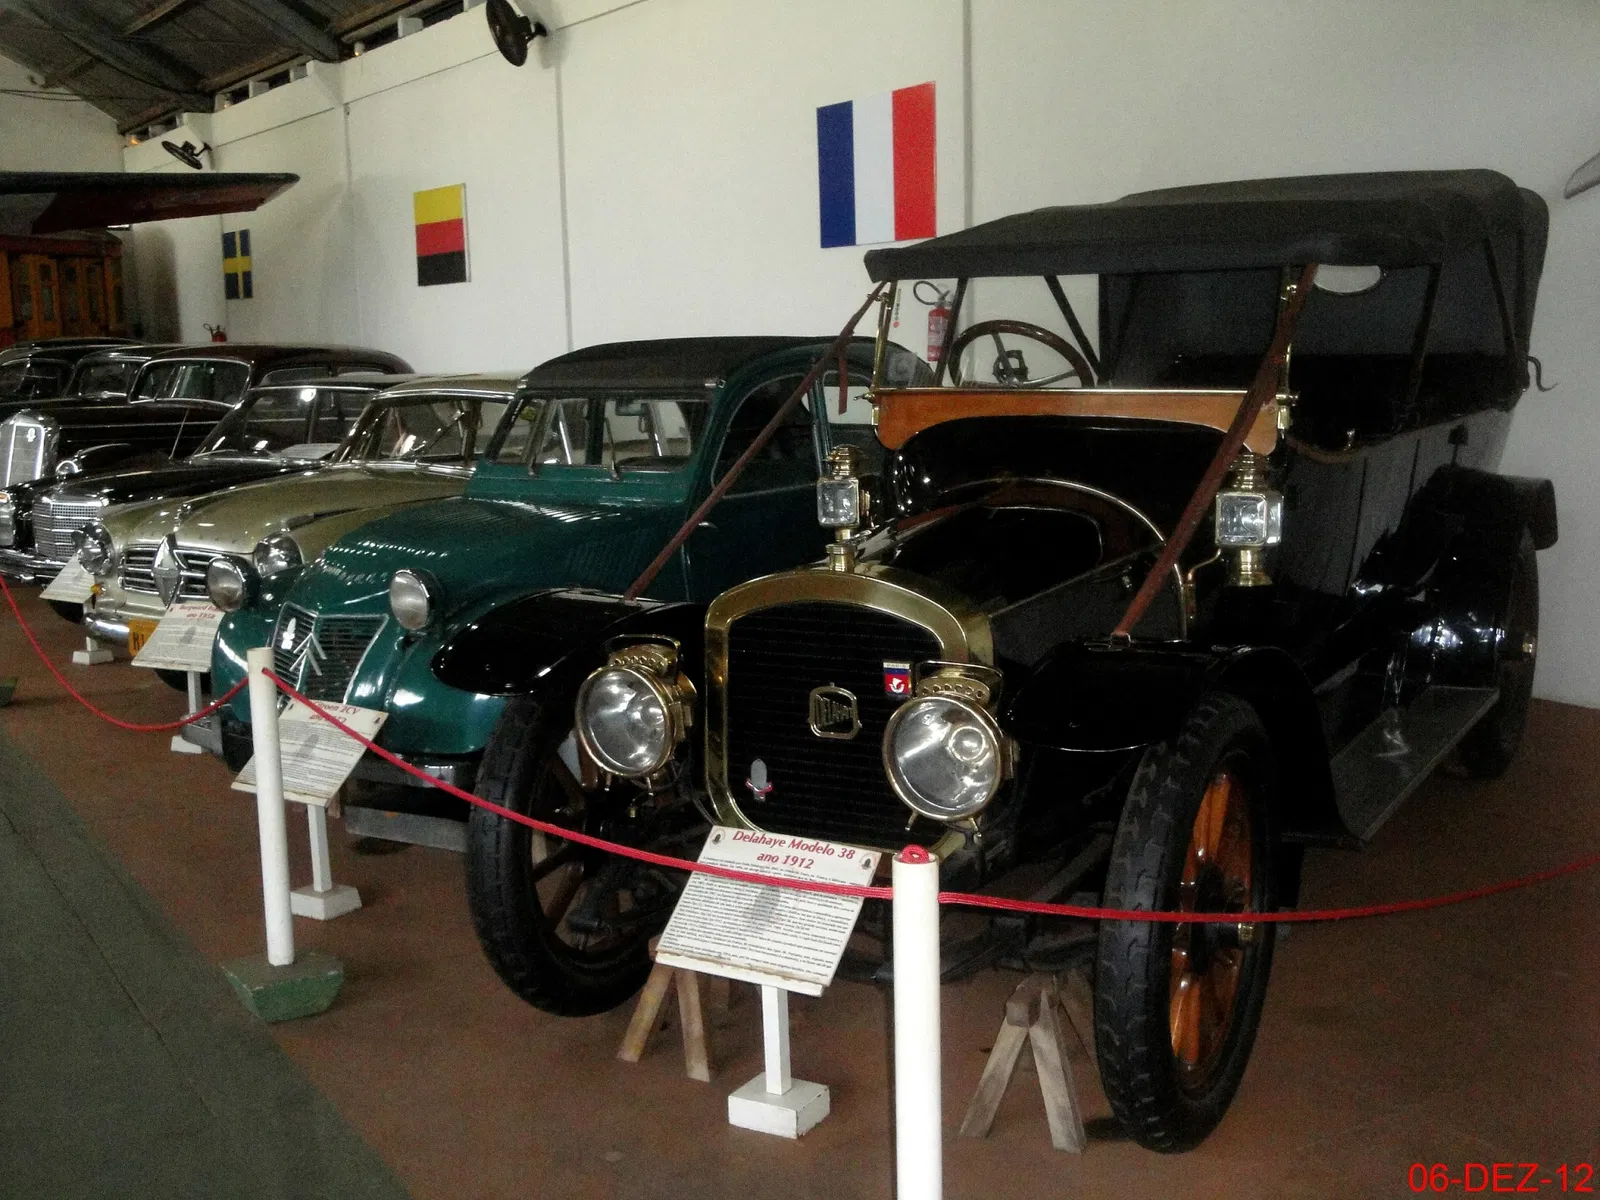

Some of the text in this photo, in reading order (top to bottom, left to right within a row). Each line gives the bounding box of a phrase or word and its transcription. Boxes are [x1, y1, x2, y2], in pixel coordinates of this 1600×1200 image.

[340, 705, 361, 715] 2CV
[732, 829, 856, 860] Delahaye Modelo 38
[757, 851, 815, 870] ano 1912
